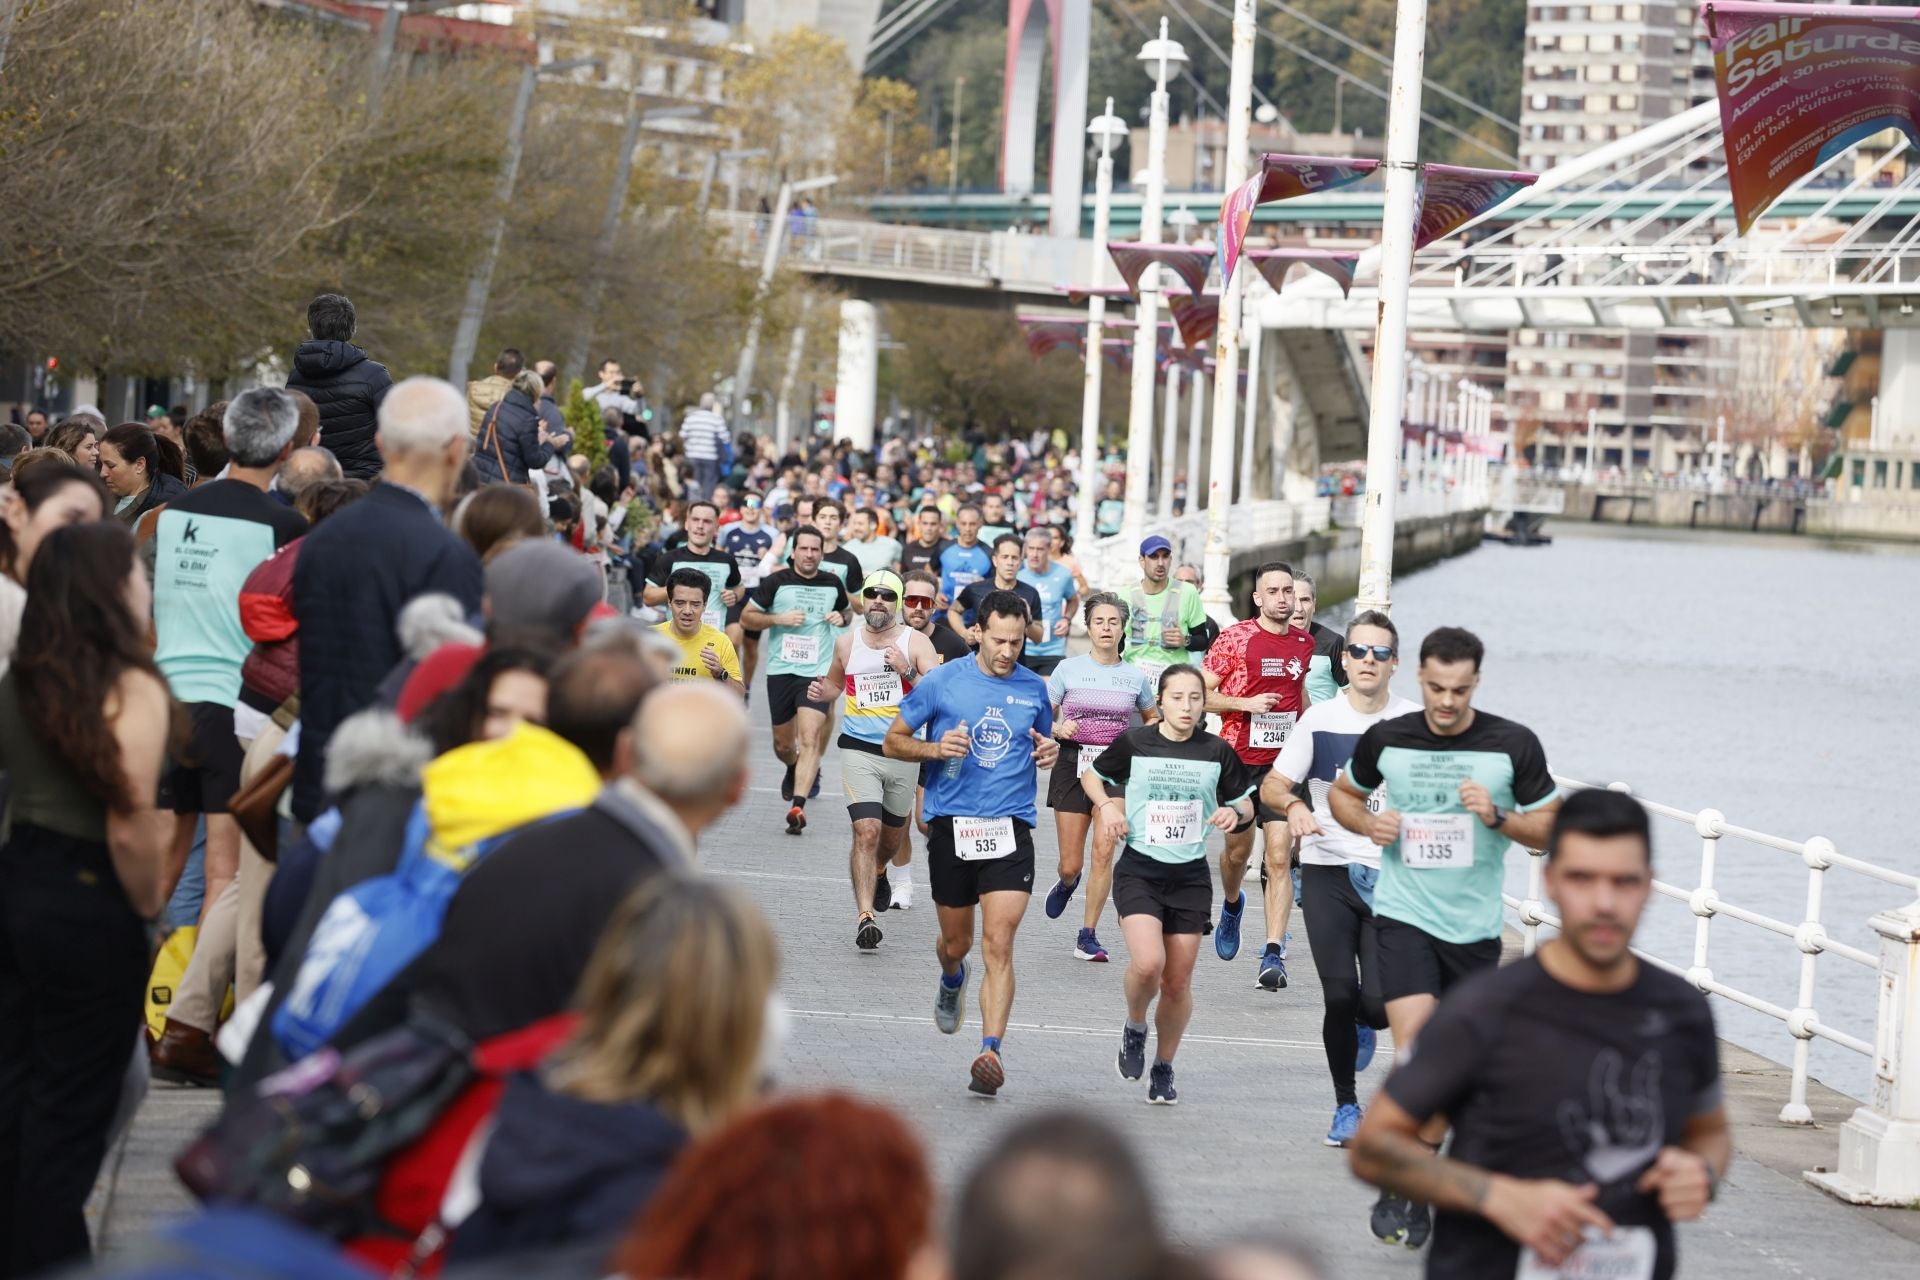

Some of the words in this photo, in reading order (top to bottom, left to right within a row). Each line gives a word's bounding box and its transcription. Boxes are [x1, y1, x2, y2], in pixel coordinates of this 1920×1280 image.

[1726, 17, 1811, 67] Fair
[1732, 75, 1789, 121] Azaroak
[1793, 64, 1814, 80] 30
[1818, 55, 1911, 72] noviembre
[1735, 134, 1750, 152] Un
[1737, 135, 1766, 166] Egun
[182, 518, 199, 543] k
[790, 649, 809, 660] 2595
[860, 682, 878, 692] XXXVI
[868, 690, 891, 702] 1547
[984, 706, 1004, 718] 21K
[1264, 732, 1285, 742] 2346
[1150, 814, 1174, 824] XXXVI
[960, 828, 983, 839] XXXVI
[1166, 826, 1186, 839] 347
[976, 839, 996, 852] 535
[1419, 844, 1452, 860] 1335
